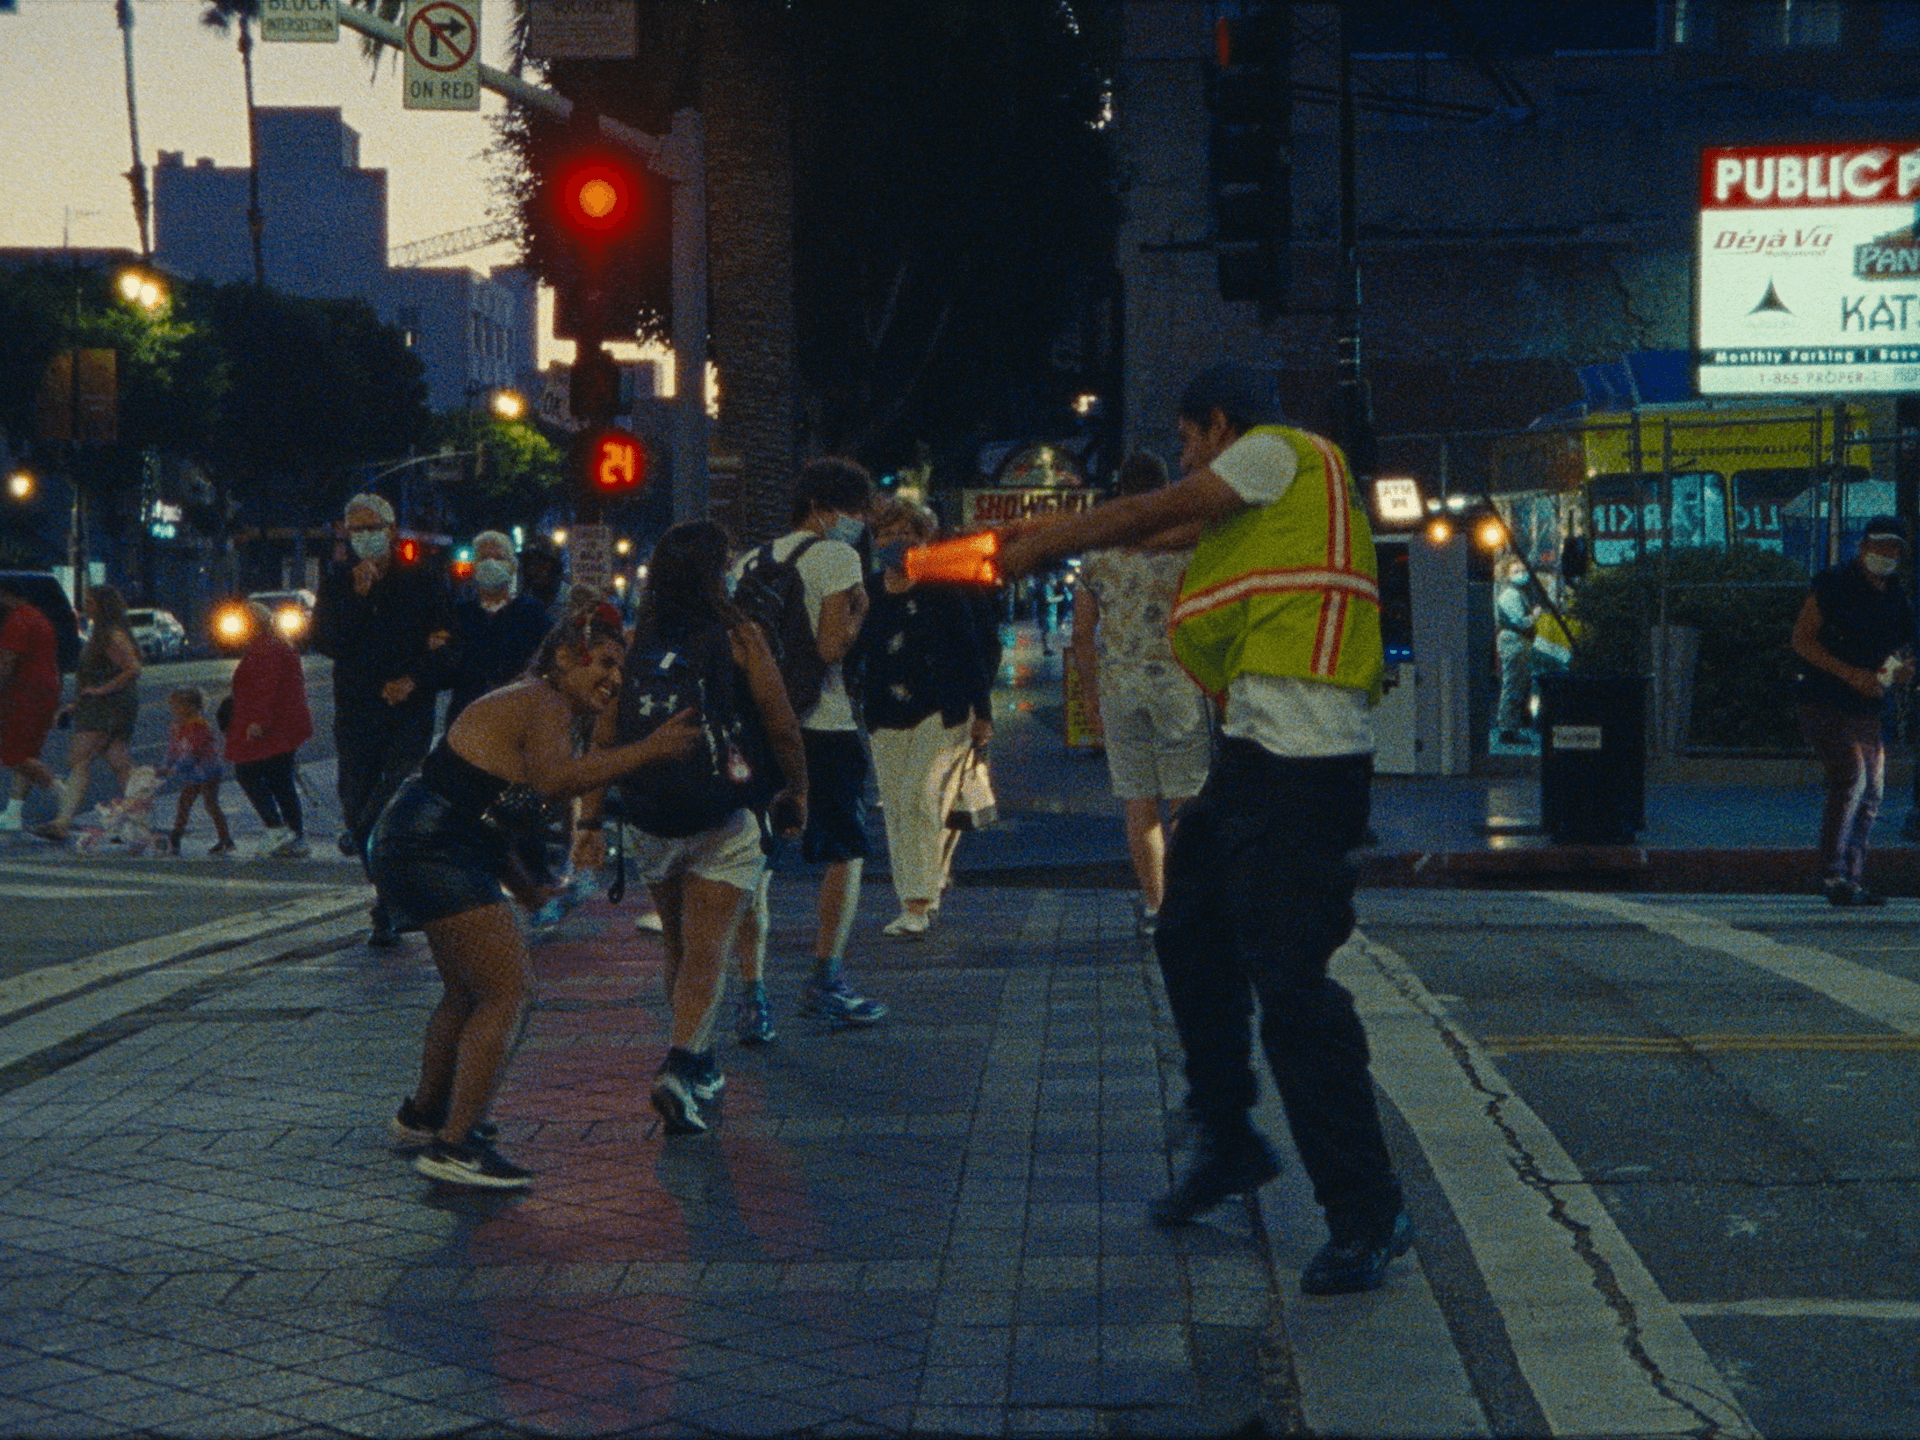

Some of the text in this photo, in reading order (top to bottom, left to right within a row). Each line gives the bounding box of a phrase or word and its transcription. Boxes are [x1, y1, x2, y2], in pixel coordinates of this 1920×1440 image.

[410, 81, 474, 100] ON RED
[1716, 153, 1883, 199] PUBLIC
[1794, 225, 1834, 248] Vu
[1840, 294, 1920, 332] KAT
[1715, 350, 1783, 364] Monthly
[1789, 348, 1855, 363] Parking
[600, 442, 635, 484] 24
[1383, 485, 1412, 497] ATM
